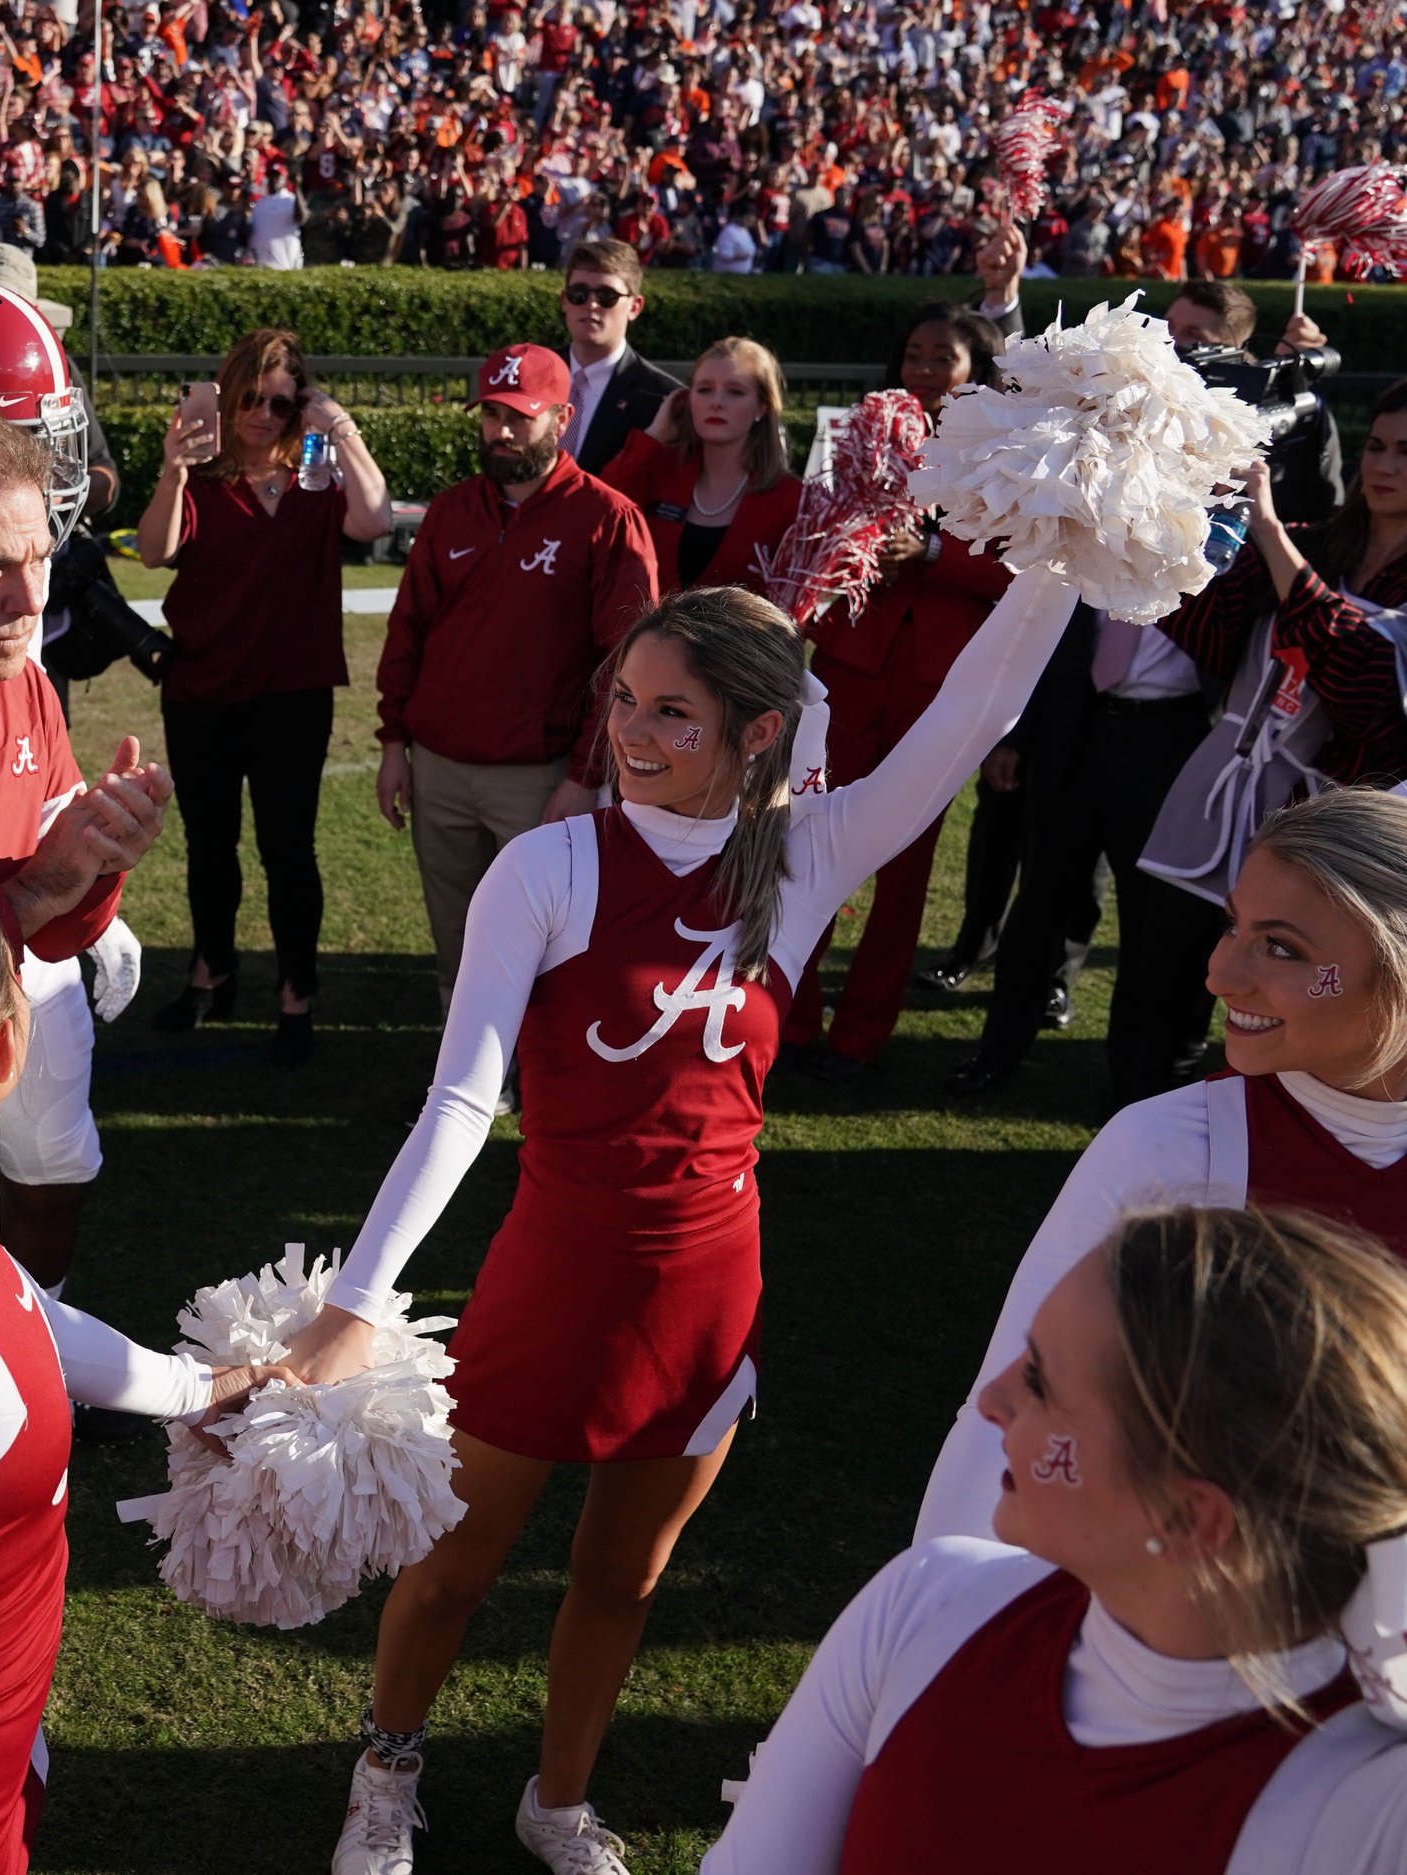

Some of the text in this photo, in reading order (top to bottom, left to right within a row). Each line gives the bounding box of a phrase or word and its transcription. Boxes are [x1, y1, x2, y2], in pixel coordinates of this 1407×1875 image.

[489, 355, 523, 386] A
[520, 538, 561, 576] A
[12, 736, 39, 775] A
[674, 726, 702, 751] A
[792, 767, 824, 796] A
[586, 916, 746, 1063] A
[1307, 964, 1344, 998] A
[1032, 1434, 1082, 1487] A
